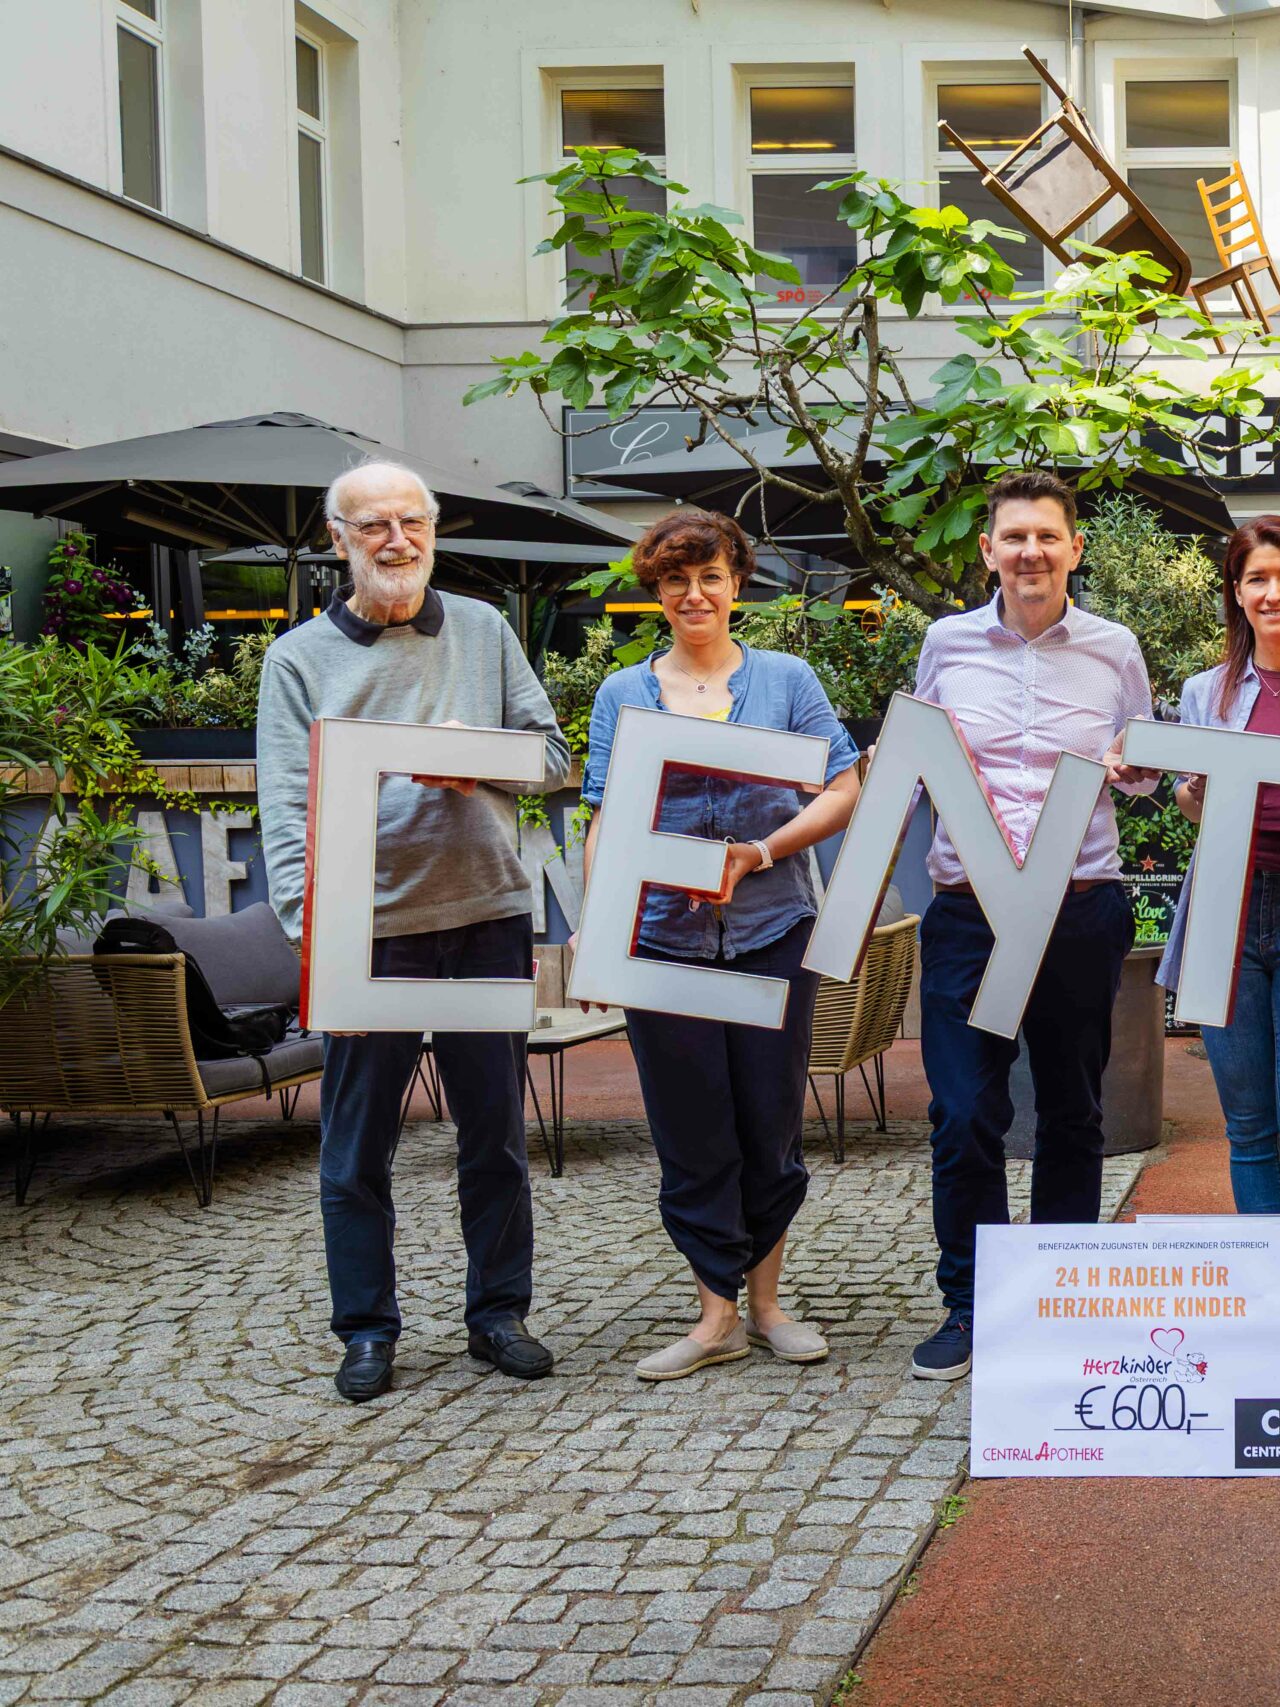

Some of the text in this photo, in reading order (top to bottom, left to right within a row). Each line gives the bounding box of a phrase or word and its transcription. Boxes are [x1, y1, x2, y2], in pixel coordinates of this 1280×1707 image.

[777, 287, 805, 303] SPÖ
[1038, 1239, 1269, 1251] BENEFIZAKTION ZUGUNSTEN DER HERZKINDER ÖSTERREICH
[1055, 1261, 1229, 1287] 24 H RADELN FÜR
[1038, 1297, 1247, 1318] HERZKRANKE KINDER
[1261, 1409, 1280, 1436] C
